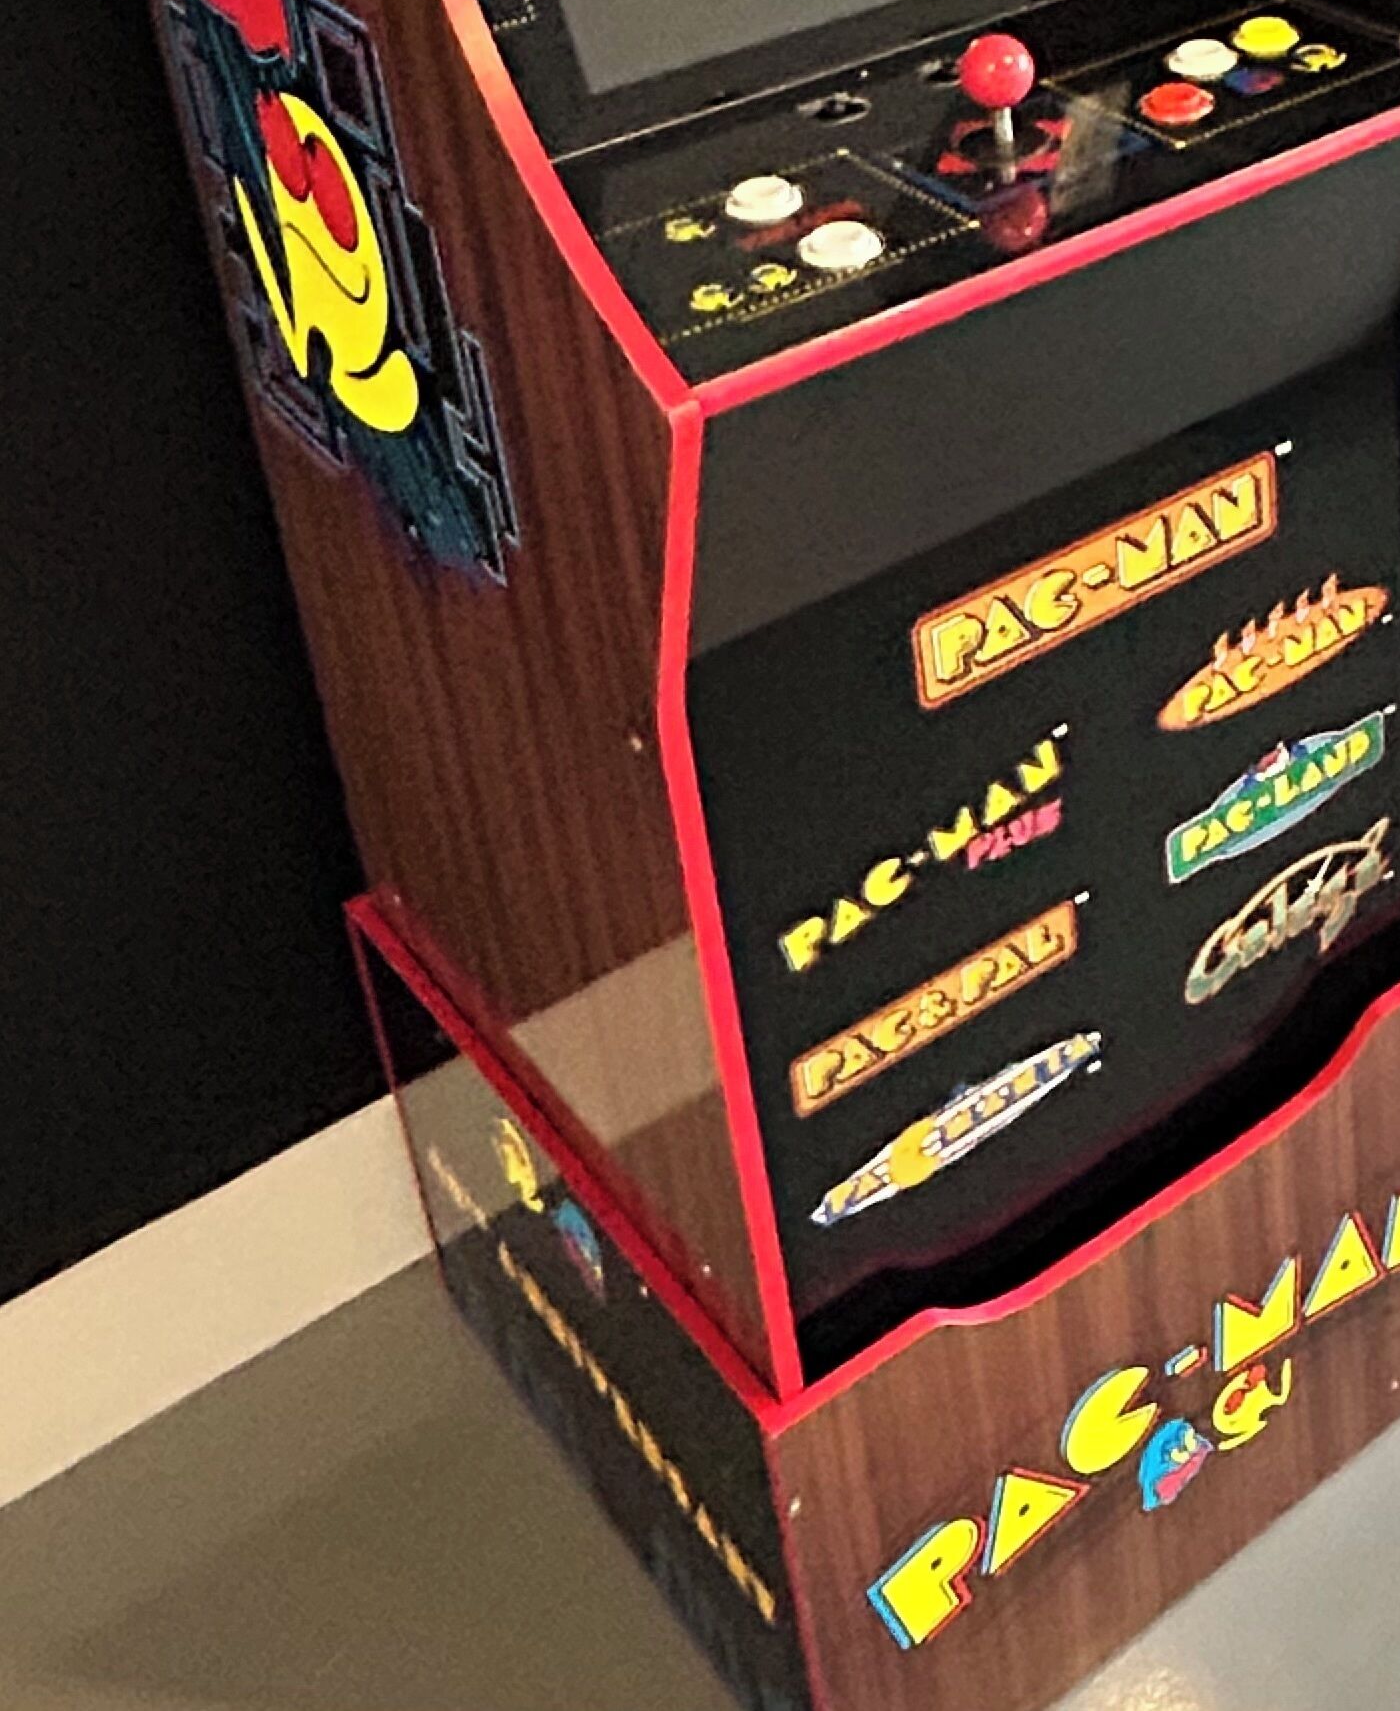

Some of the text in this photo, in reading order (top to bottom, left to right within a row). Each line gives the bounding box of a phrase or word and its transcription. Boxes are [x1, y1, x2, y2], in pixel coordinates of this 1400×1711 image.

[930, 472, 1264, 685] PAC-MAN
[1182, 597, 1372, 723] PAC-MAN
[778, 738, 1062, 972] PAC-MAN
[967, 797, 1062, 870] PLUS
[1179, 729, 1370, 863] PAC-LAND
